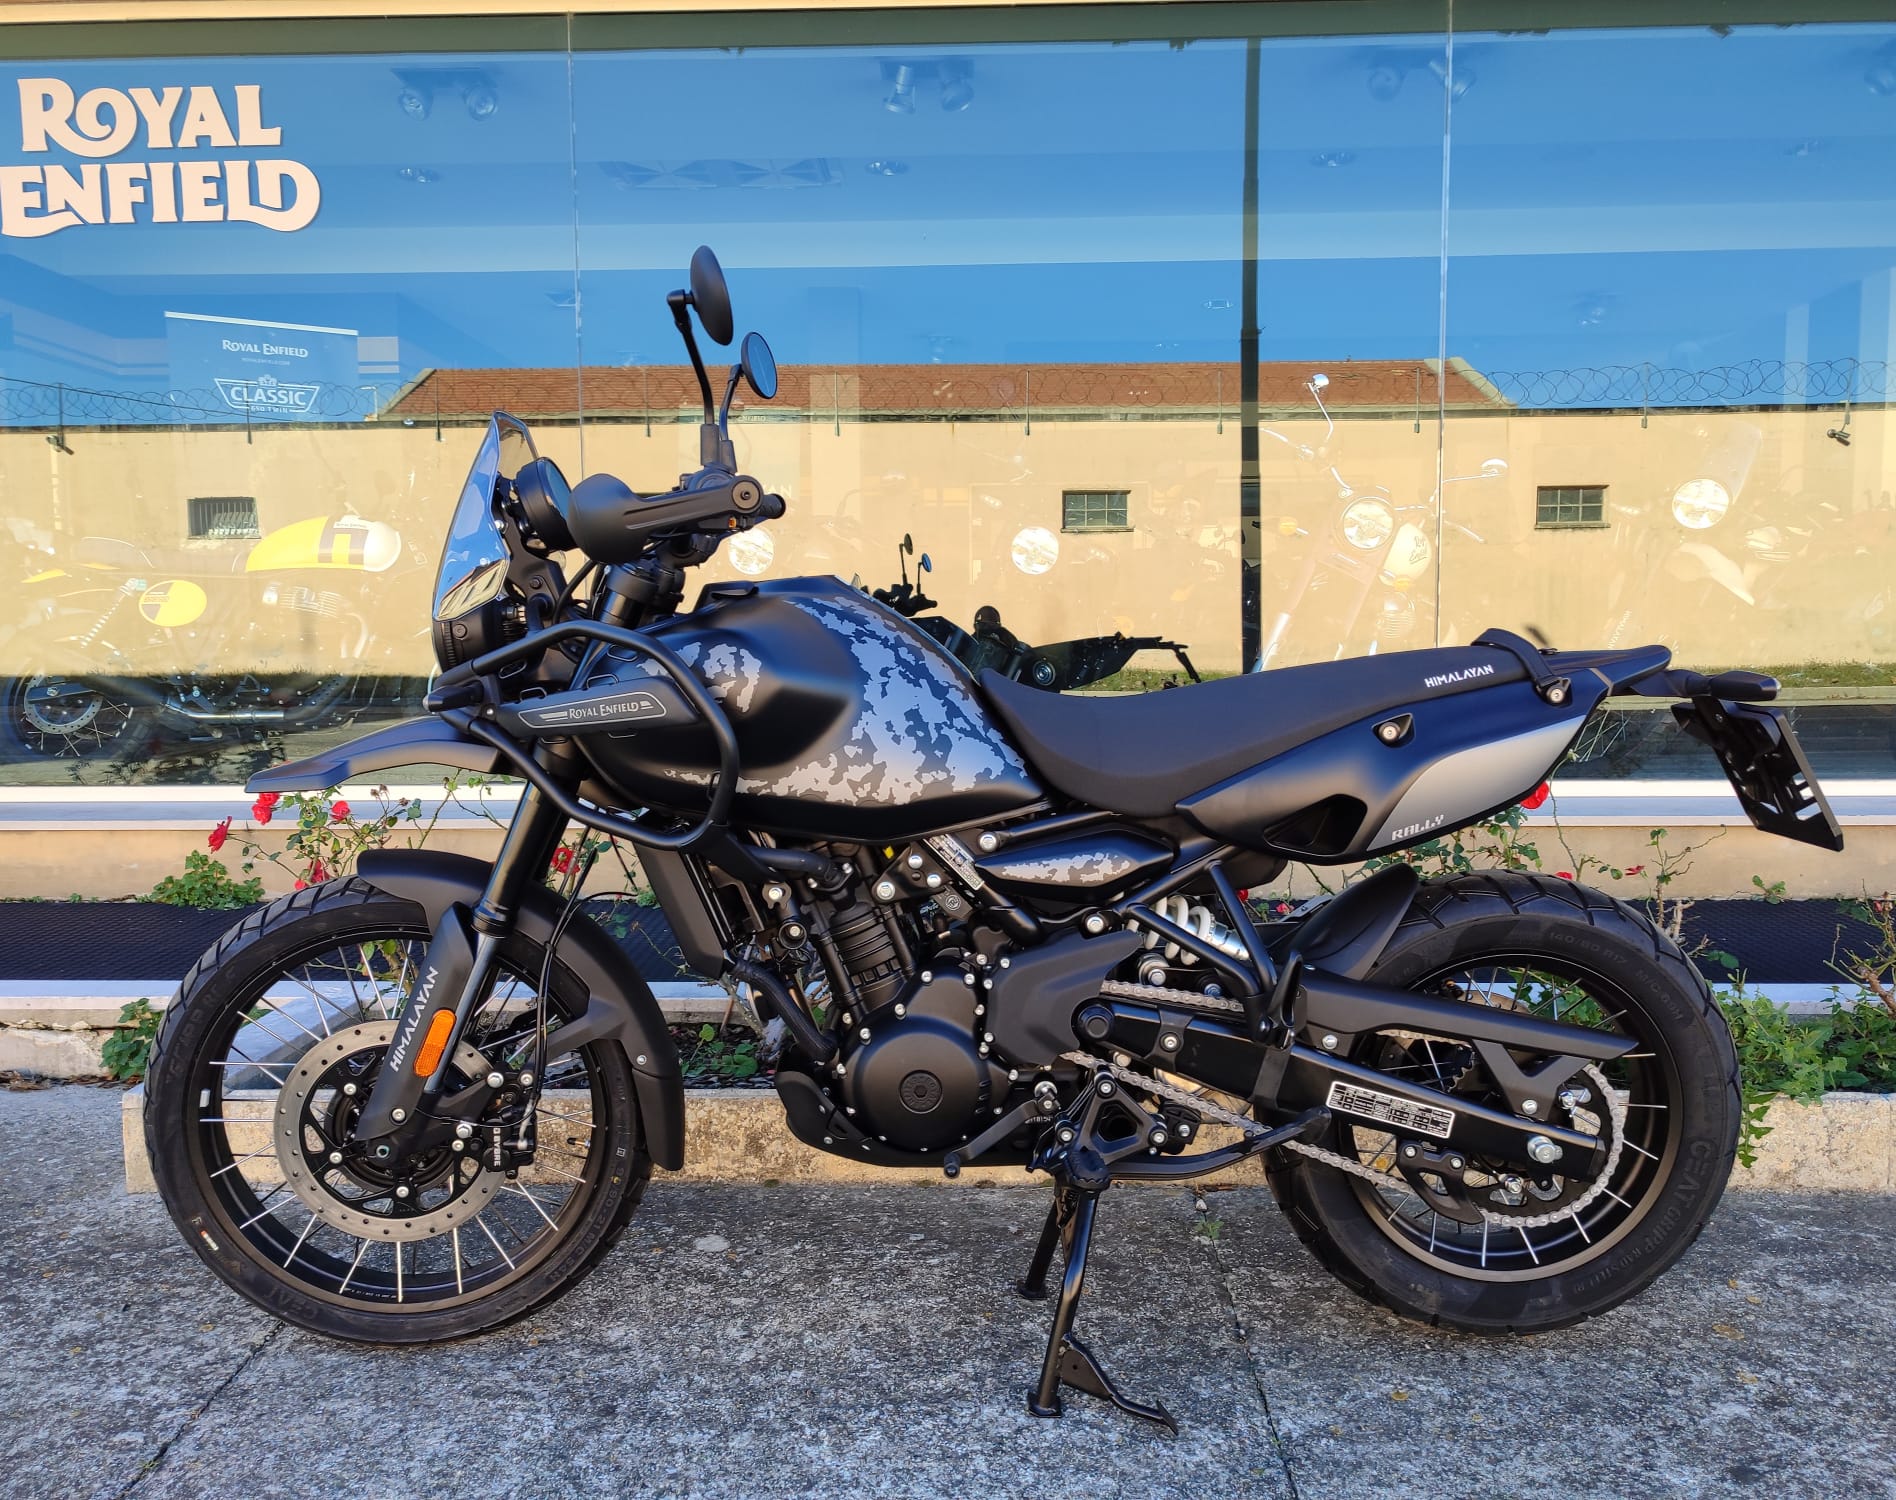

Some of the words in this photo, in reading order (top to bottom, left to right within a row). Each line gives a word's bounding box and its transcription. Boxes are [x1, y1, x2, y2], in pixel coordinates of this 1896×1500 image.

[17, 78, 282, 157] ROYAL
[0, 160, 321, 238] ENFIELD
[222, 339, 260, 352] ROYAL
[262, 343, 308, 358] ENFIELD
[230, 386, 306, 406] CLASSIC
[267, 406, 288, 414] TWIN
[1424, 664, 1494, 688] HIMALAYAN
[569, 707, 598, 719] ROYAL
[599, 702, 640, 717] ENFIELD
[1391, 814, 1444, 841] RALLY
[390, 965, 439, 1073] HIMALAYAN
[1673, 1140, 1717, 1209] CEAT
